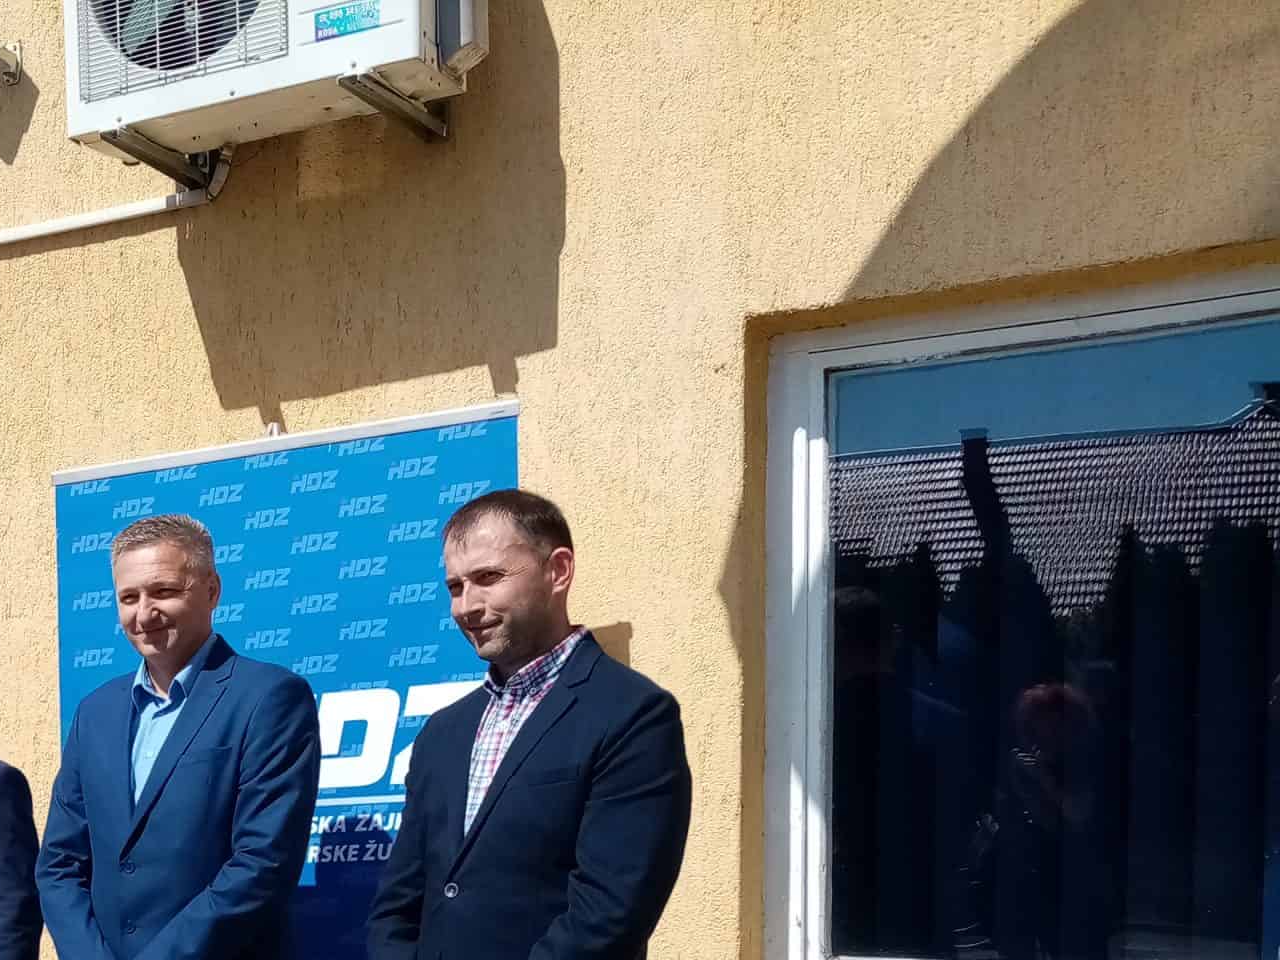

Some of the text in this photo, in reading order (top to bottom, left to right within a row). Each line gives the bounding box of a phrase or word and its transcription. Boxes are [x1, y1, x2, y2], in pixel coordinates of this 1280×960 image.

[387, 456, 438, 480] HDZ
[290, 470, 339, 494] HDZ
[199, 484, 245, 506] HDZ
[338, 495, 387, 518] HDZ
[113, 497, 155, 519] HDZ
[244, 507, 290, 530] HDZ
[388, 519, 438, 543] HDZ
[72, 532, 113, 554] HDZ
[214, 544, 245, 564] DZ
[290, 531, 339, 555] HDZ
[245, 568, 290, 591] HDZ
[338, 556, 388, 580] HDZ
[72, 590, 113, 611] HDZ
[290, 592, 339, 615] HDZ
[388, 582, 439, 606] HDZ
[213, 604, 245, 624] DZ
[245, 628, 291, 650] HDZ
[339, 618, 388, 641] HDZ
[73, 648, 115, 668] HDZ
[292, 653, 339, 675] HDZ
[388, 644, 440, 668] HDZ
[310, 811, 402, 834] SKA ZAJ
[306, 840, 393, 863] RSKE ŽU
